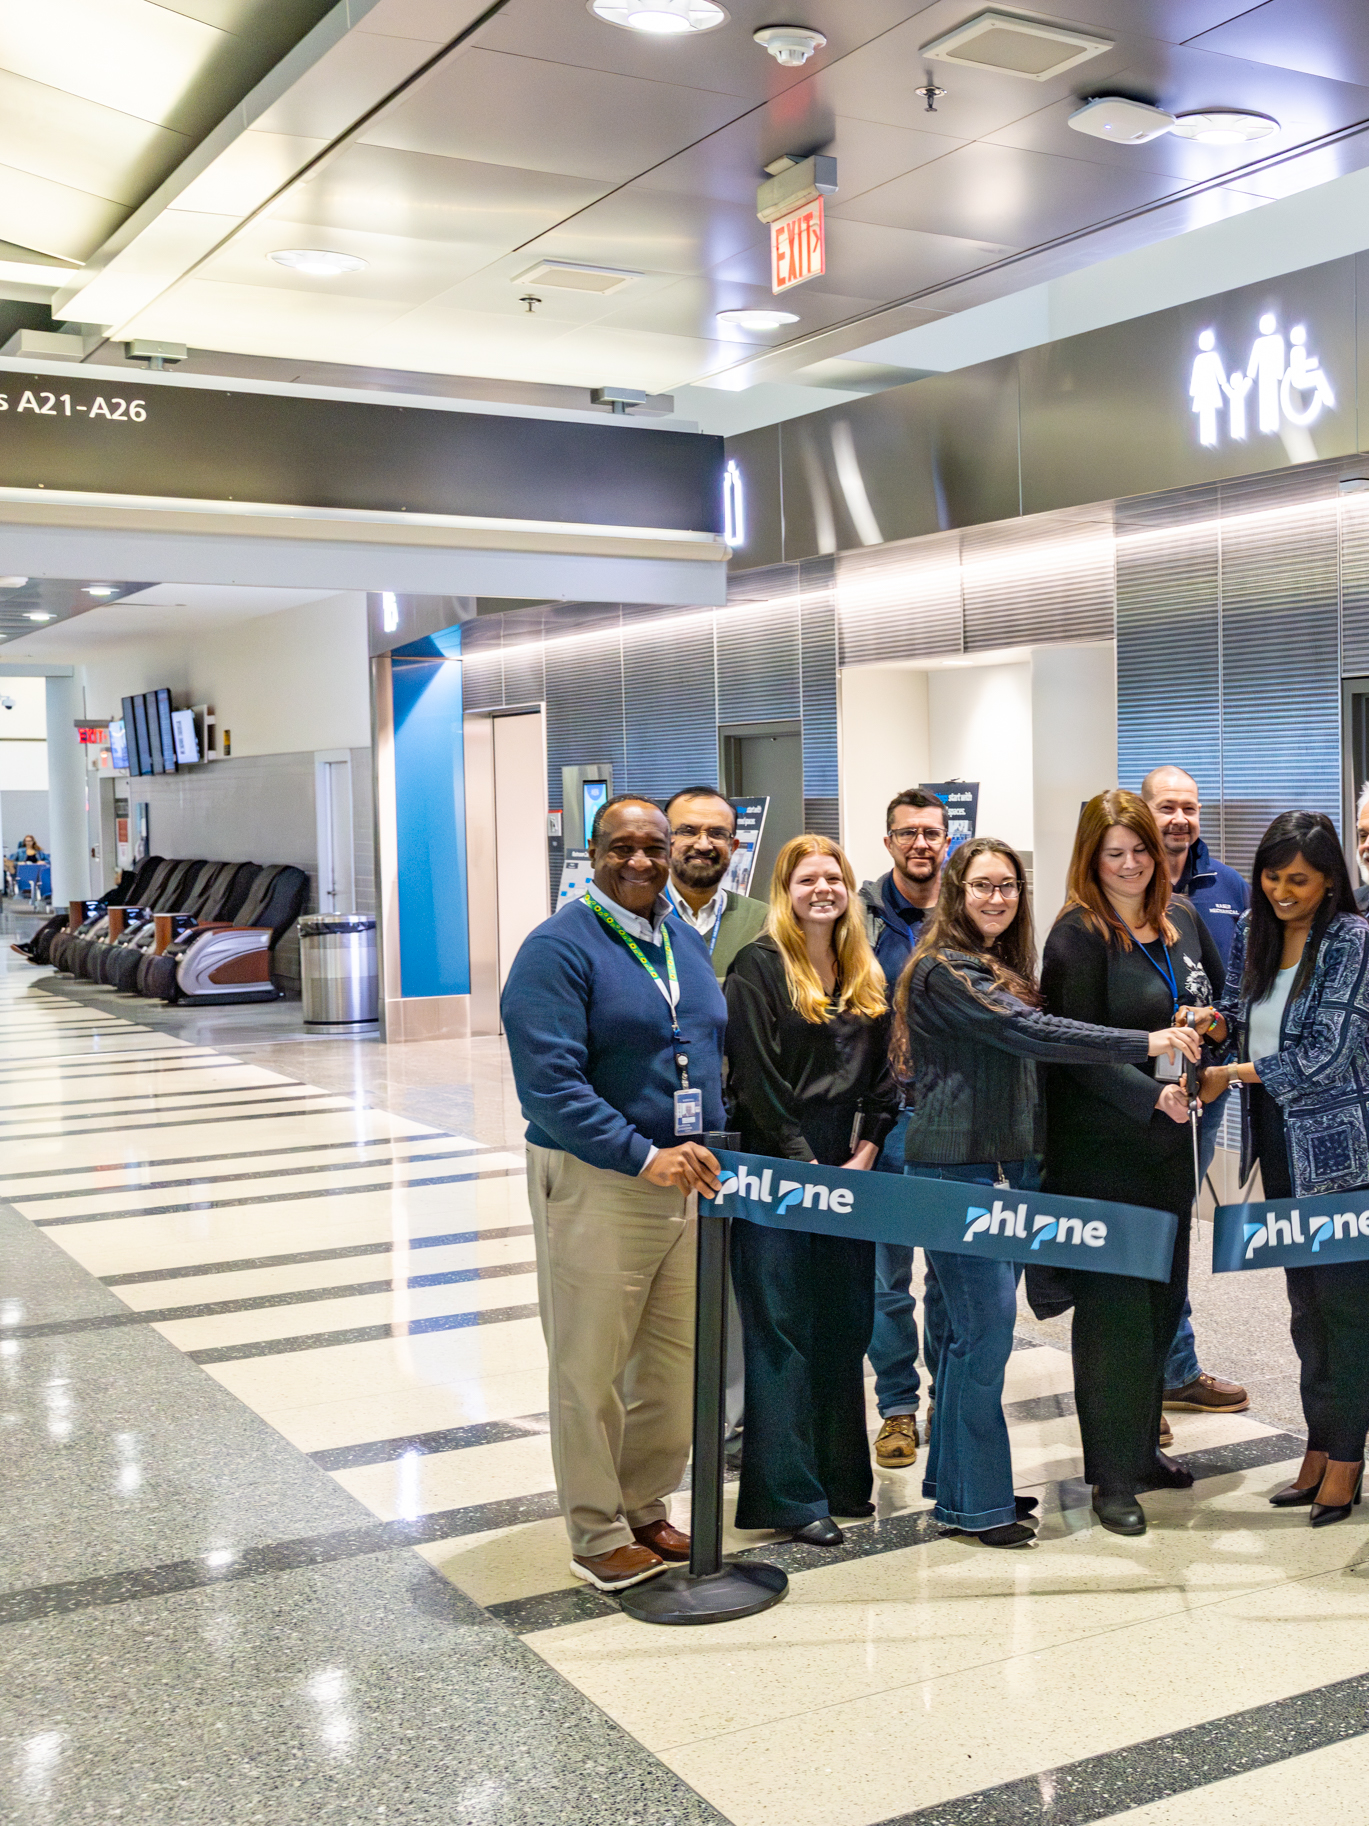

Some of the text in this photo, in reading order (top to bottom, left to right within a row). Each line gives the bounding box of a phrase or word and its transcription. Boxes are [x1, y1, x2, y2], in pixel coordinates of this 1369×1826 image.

[775, 210, 814, 288] EXIT
[17, 390, 147, 422] A21-A26
[78, 728, 105, 744] EXIT
